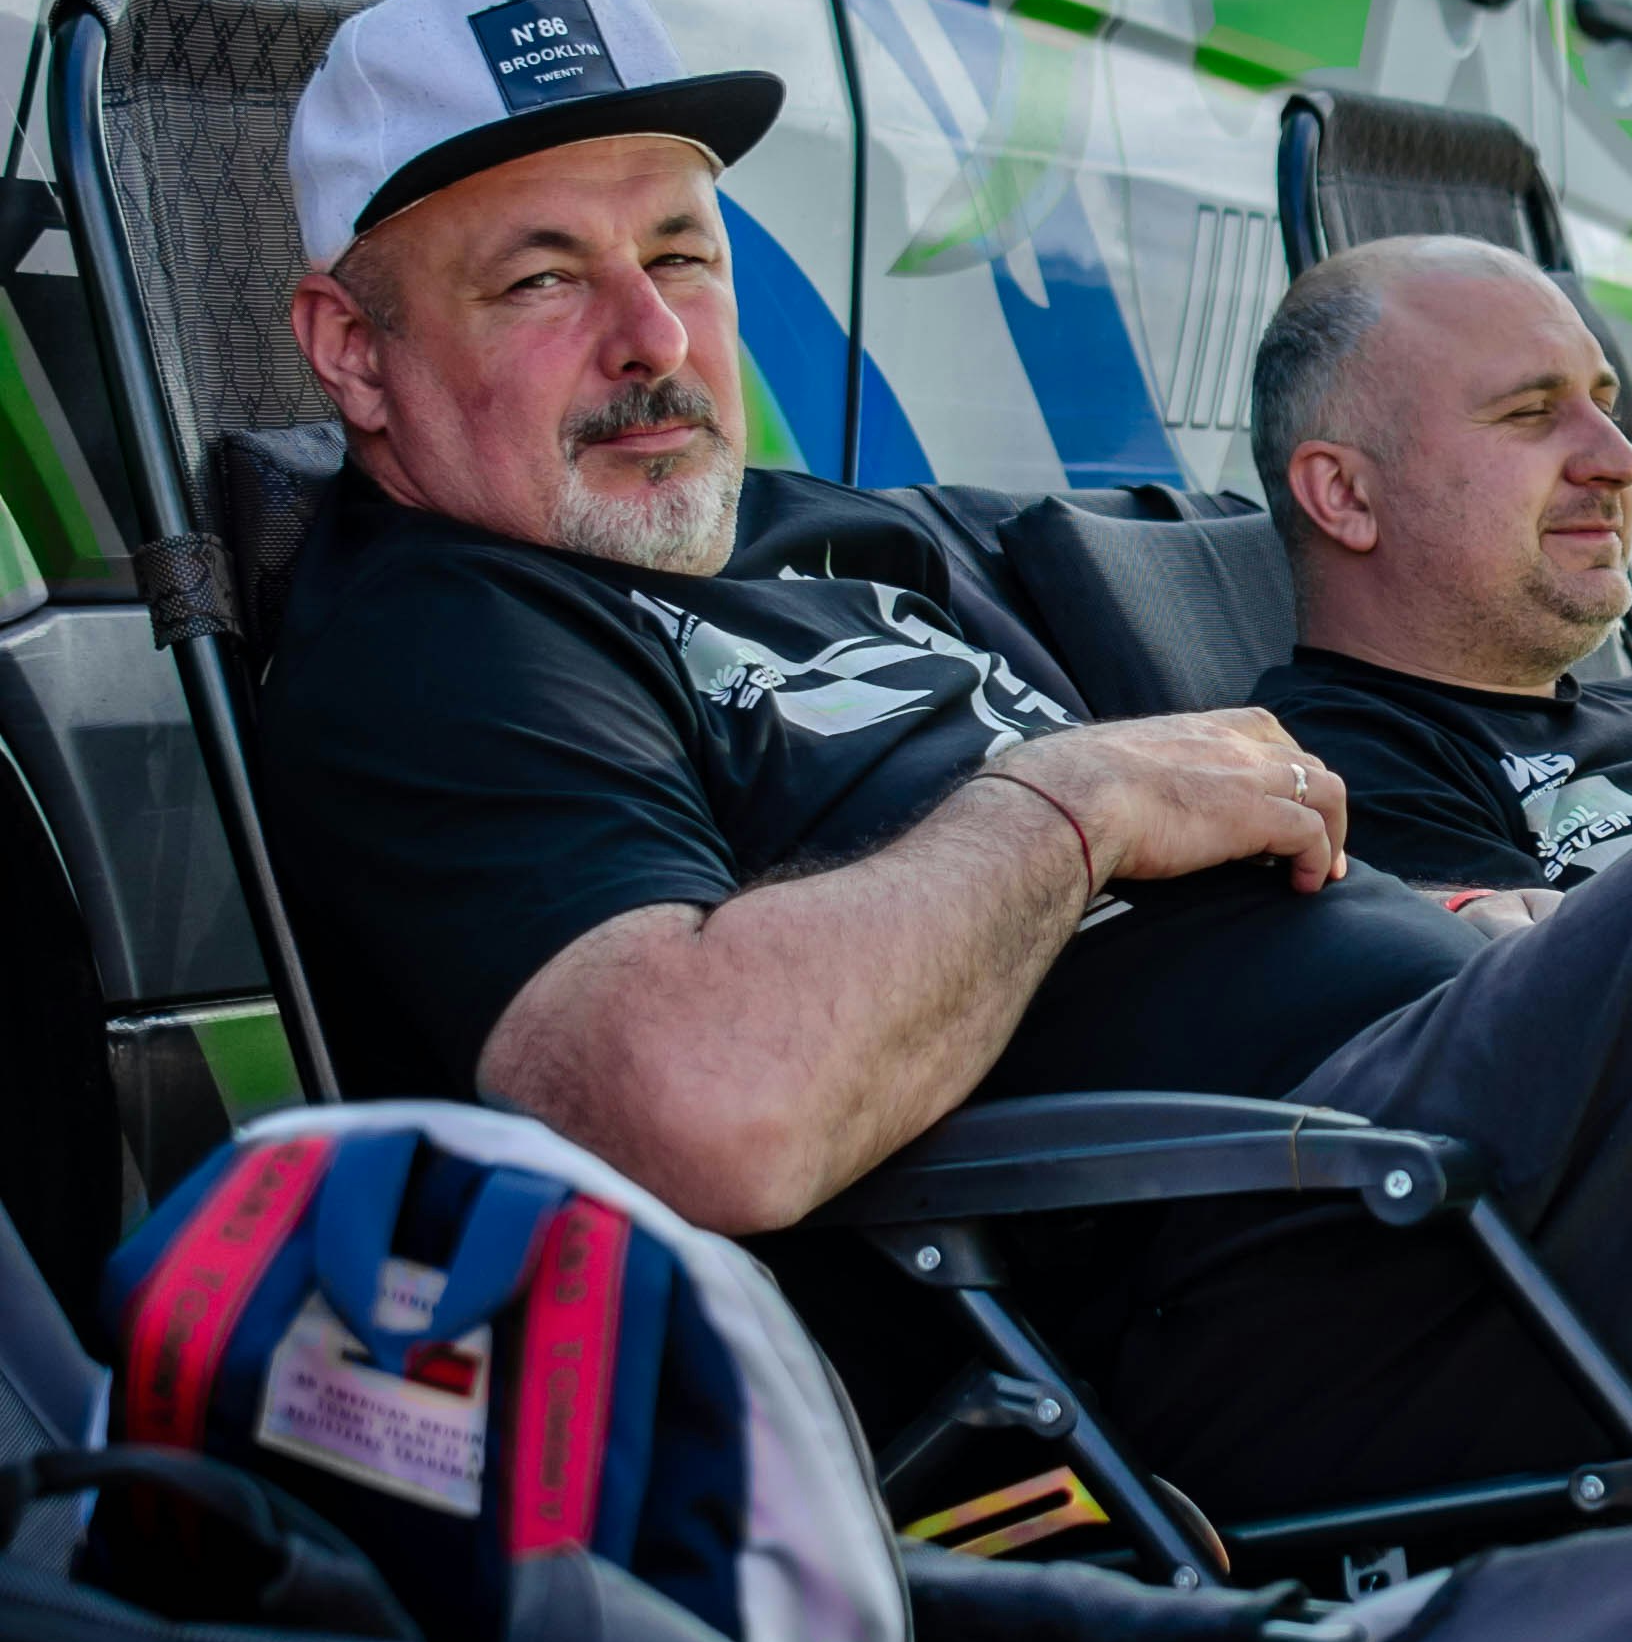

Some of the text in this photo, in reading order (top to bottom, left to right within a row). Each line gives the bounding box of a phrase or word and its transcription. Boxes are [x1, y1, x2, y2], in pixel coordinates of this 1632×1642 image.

[499, 43, 600, 75] BROOKLYN
[533, 66, 585, 84] TWENTY
[1544, 810, 1632, 882] SEVEN
